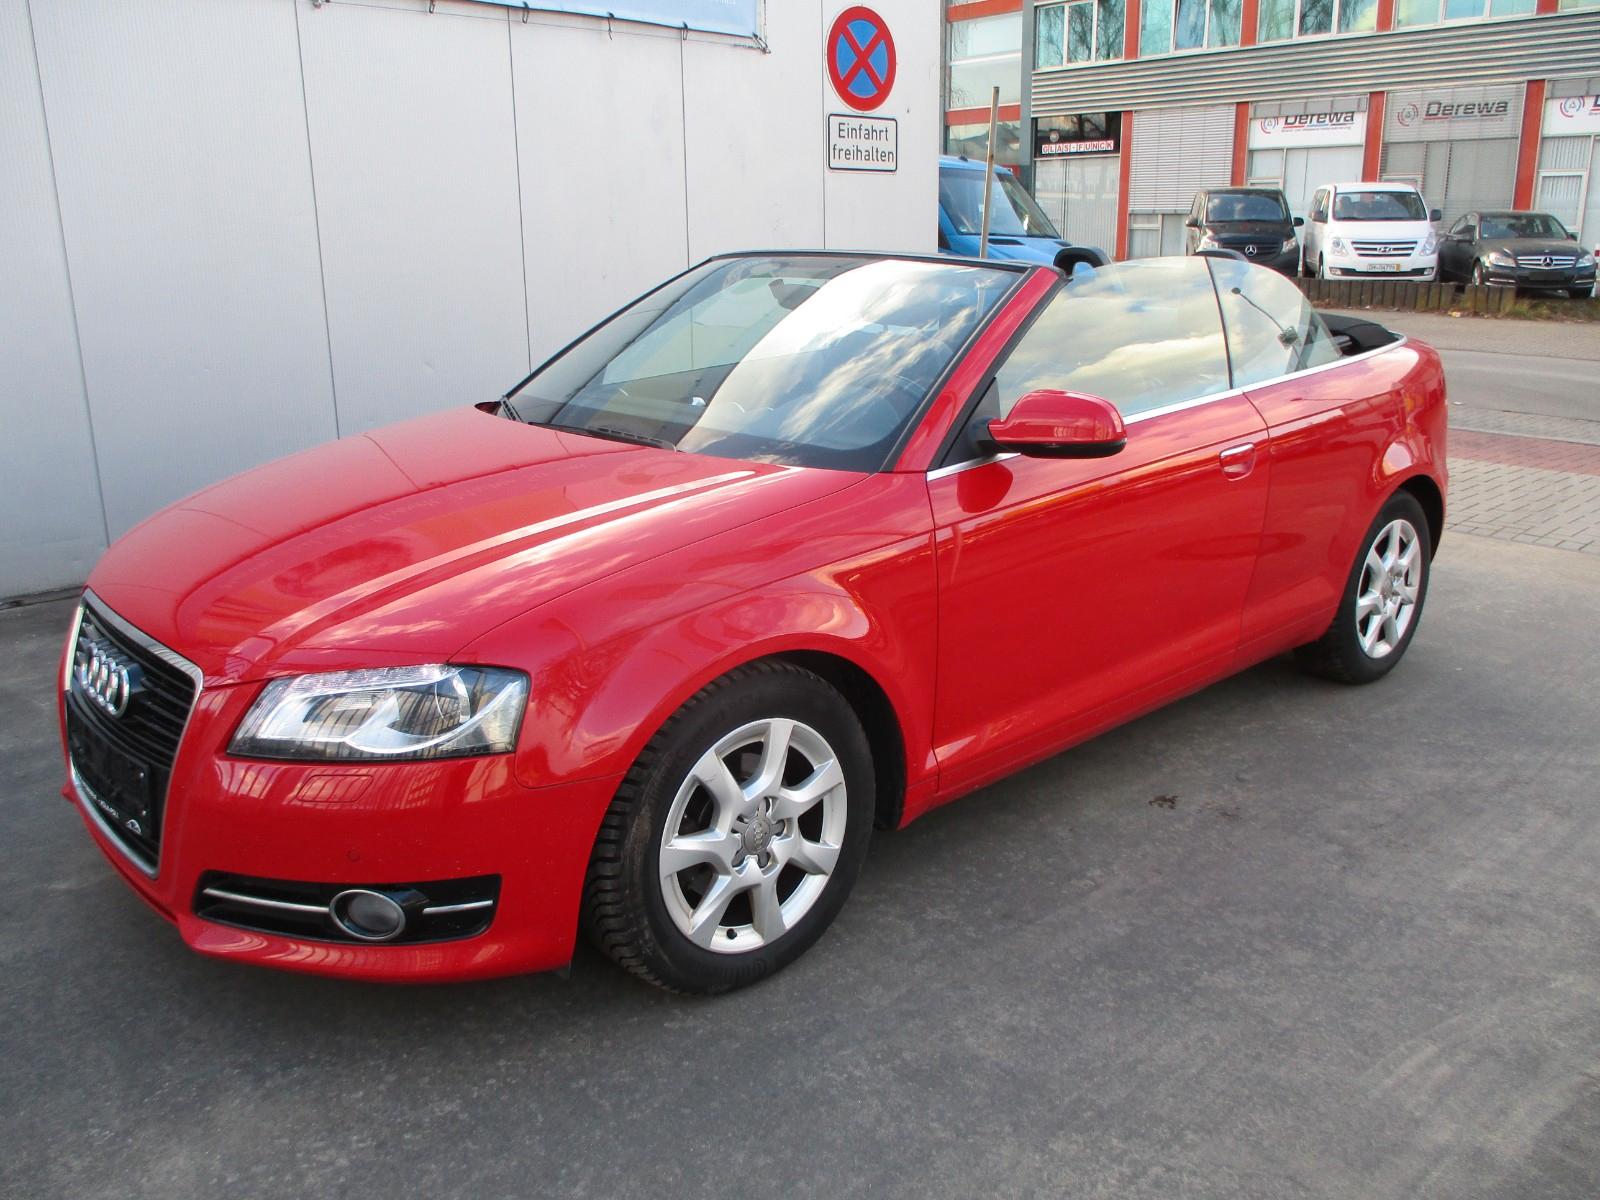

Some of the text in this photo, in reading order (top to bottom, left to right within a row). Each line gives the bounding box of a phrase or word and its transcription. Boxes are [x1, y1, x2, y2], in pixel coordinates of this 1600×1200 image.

[1425, 100, 1509, 117] Derewa
[1284, 111, 1355, 126] Derewa
[838, 122, 889, 141] Einfahrt
[832, 143, 894, 163] freihalten
